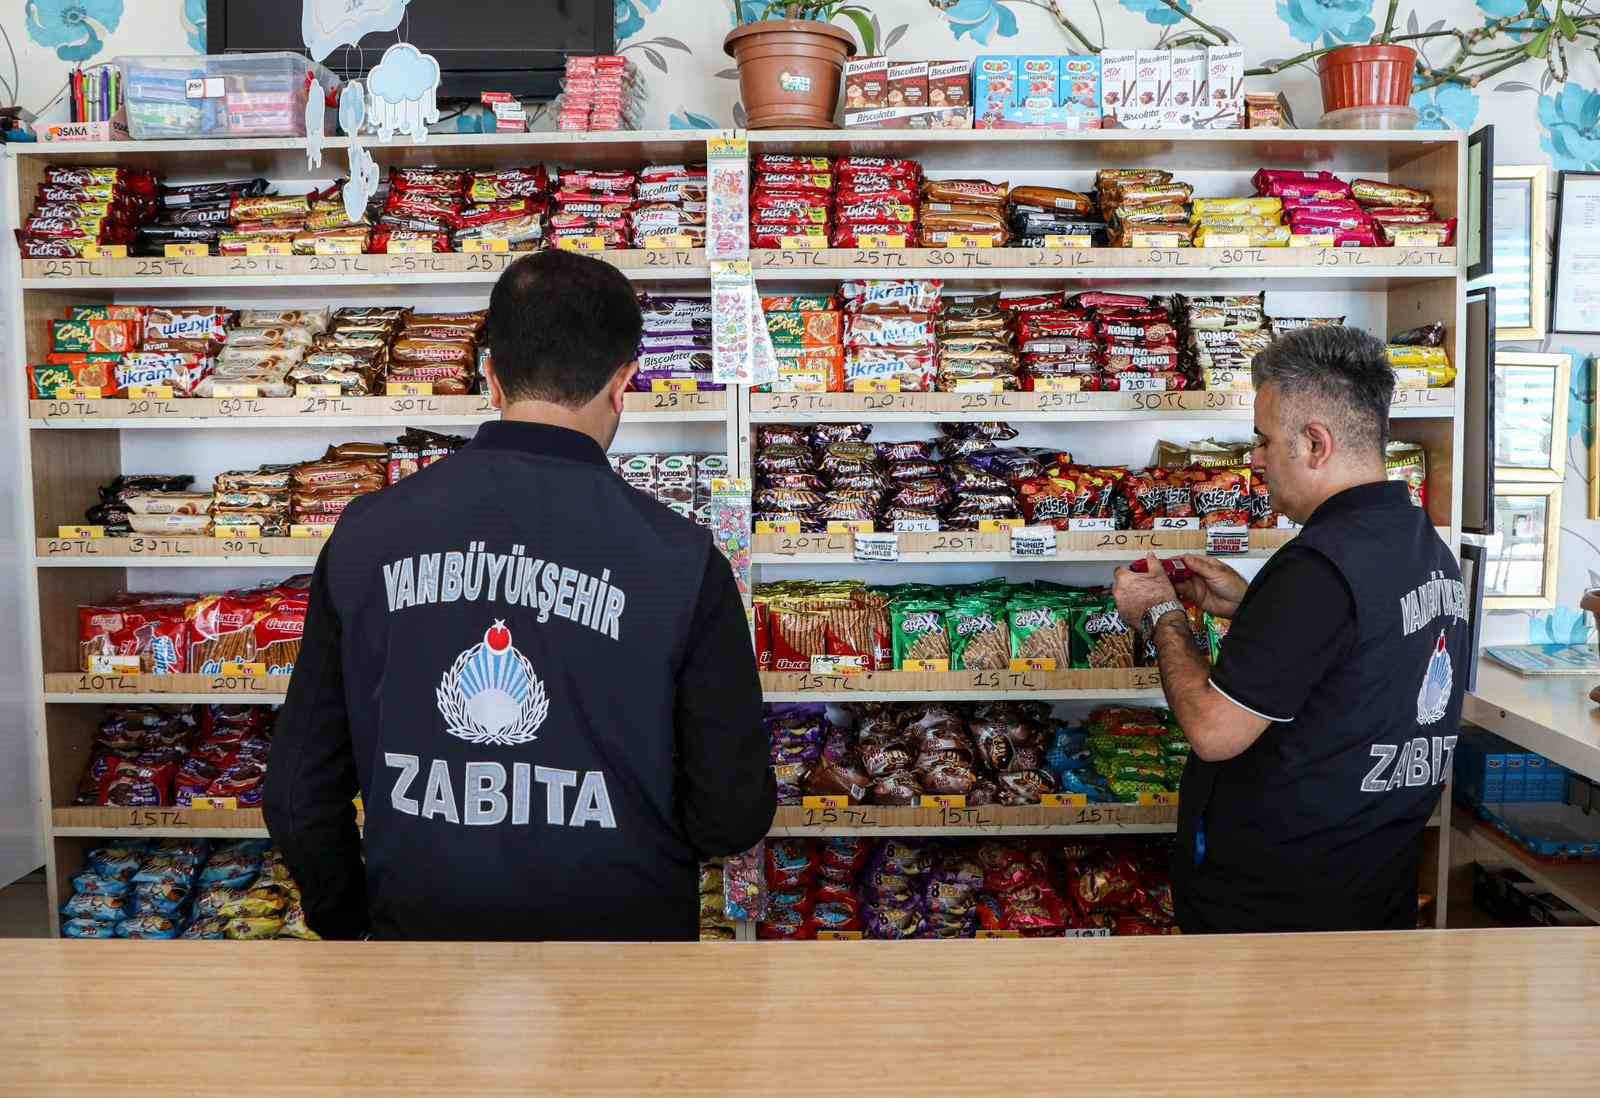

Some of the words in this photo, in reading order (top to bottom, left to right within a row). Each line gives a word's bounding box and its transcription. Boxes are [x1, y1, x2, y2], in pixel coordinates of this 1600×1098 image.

[849, 60, 885, 72] Biscolata
[889, 65, 926, 76] Biscolata
[931, 64, 967, 76] Biscolata
[857, 110, 896, 122] Biscolata
[565, 204, 602, 212] KOMBO
[25, 243, 61, 256] Tutku
[466, 254, 492, 270] 25
[676, 252, 692, 265] TL
[854, 251, 878, 264] 25
[881, 253, 908, 266] TL
[927, 250, 954, 264] 30
[962, 252, 992, 266] TL
[1220, 251, 1242, 263] 30
[1244, 250, 1265, 261] TL
[1344, 252, 1370, 264] TL
[869, 285, 919, 300] ikram
[163, 319, 210, 334] ikram
[1107, 326, 1144, 336] KOMBO
[1274, 320, 1311, 329] KOMBO
[1199, 332, 1235, 341] KOMBO
[645, 352, 690, 367] Biscolata
[850, 360, 904, 377] ikram
[123, 368, 172, 384] ikram
[1126, 380, 1143, 390] 20
[961, 395, 987, 408] 25
[1415, 389, 1439, 401] TL
[128, 402, 149, 413] 20
[153, 402, 179, 413] TL
[219, 399, 240, 414] 30
[247, 401, 265, 412] TL
[392, 399, 414, 411] 30
[417, 400, 439, 411] TL
[1133, 394, 1162, 410] 30
[1164, 394, 1188, 409] TL
[48, 402, 69, 416] 20
[74, 403, 98, 414] TL
[914, 495, 934, 504] Gong
[48, 541, 72, 553] 20
[74, 542, 99, 553] TL
[812, 538, 845, 549] TL
[933, 537, 963, 549] 20
[1097, 534, 1128, 547] 20
[1134, 535, 1162, 546] TL
[248, 542, 270, 554] TL
[903, 613, 943, 635] CRAX
[957, 614, 997, 636] CRAX
[1016, 608, 1056, 629] CRAX
[799, 675, 823, 689] 15
[973, 673, 1000, 687] 15
[1009, 673, 1035, 687] TL
[385, 752, 617, 829] ZABITA
